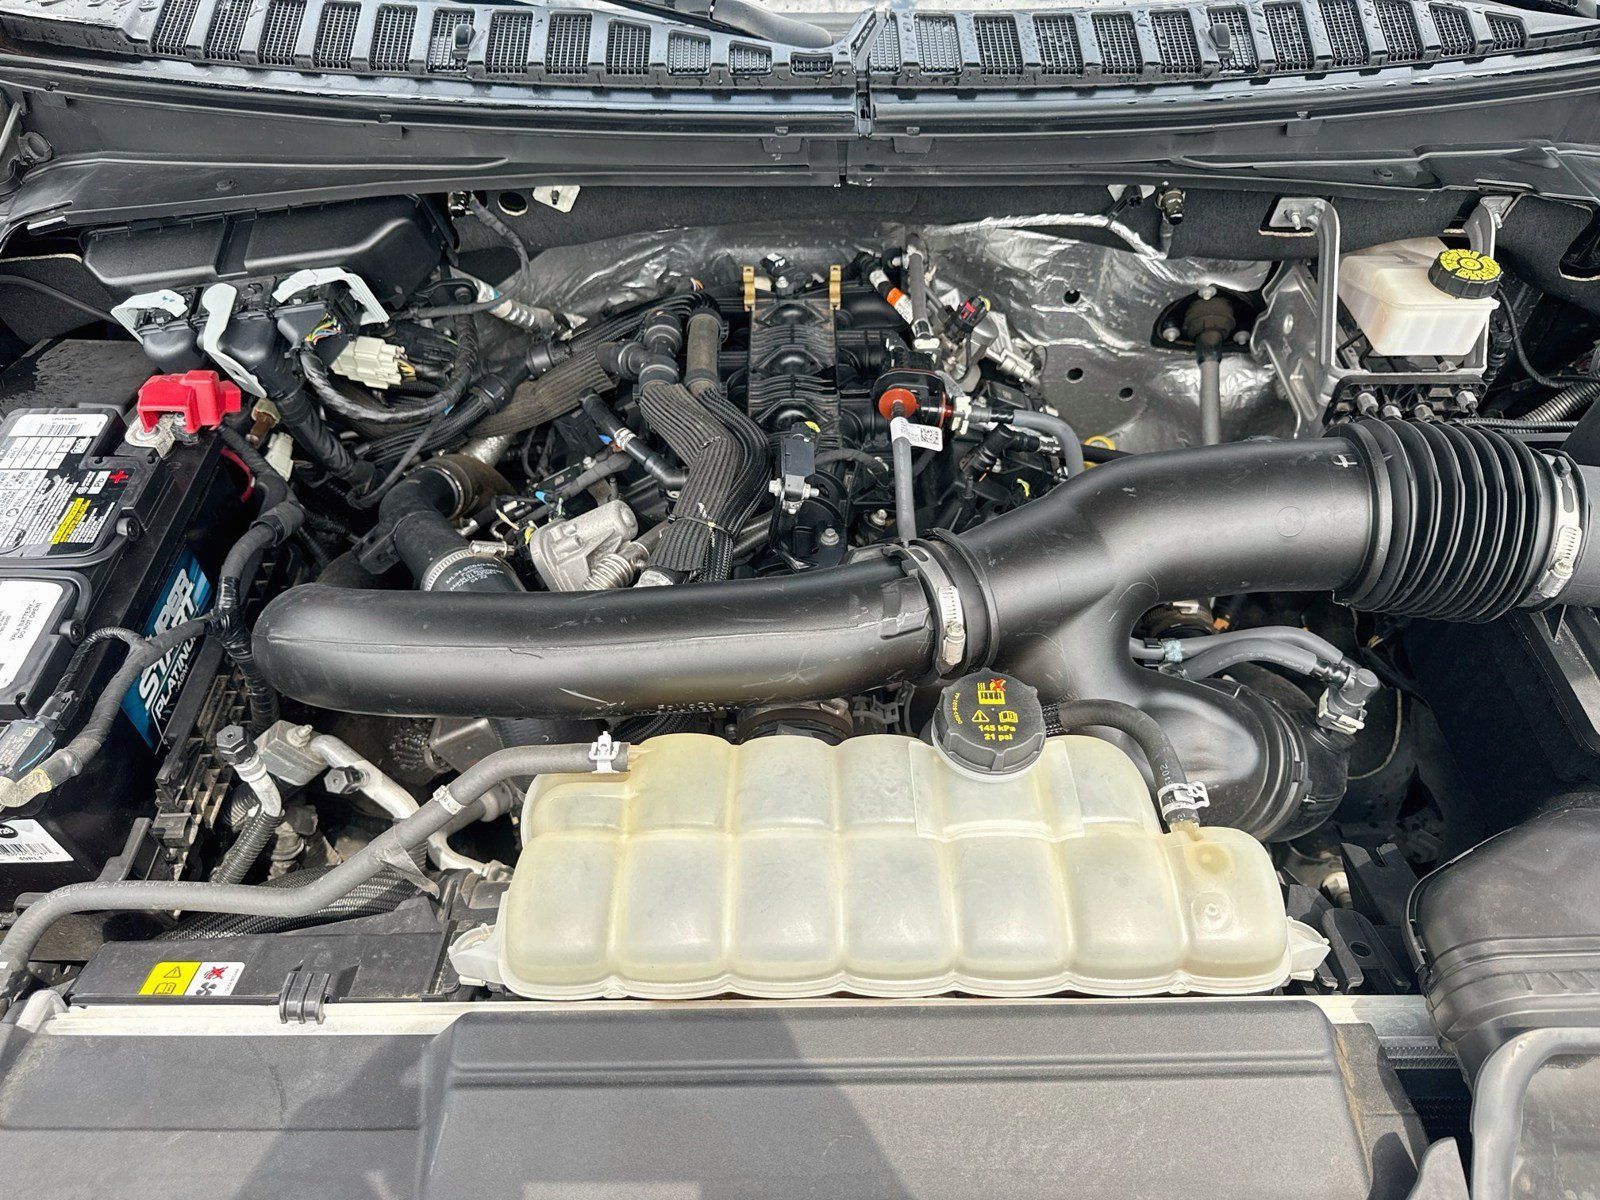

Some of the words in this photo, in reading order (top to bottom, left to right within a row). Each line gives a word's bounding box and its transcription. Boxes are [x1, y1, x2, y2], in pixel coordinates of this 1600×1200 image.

[94, 477, 105, 488] Pb
[154, 636, 197, 719] PLATINU
[979, 724, 995, 732] 145
[998, 724, 1016, 732] kPa
[998, 733, 1013, 741] psi
